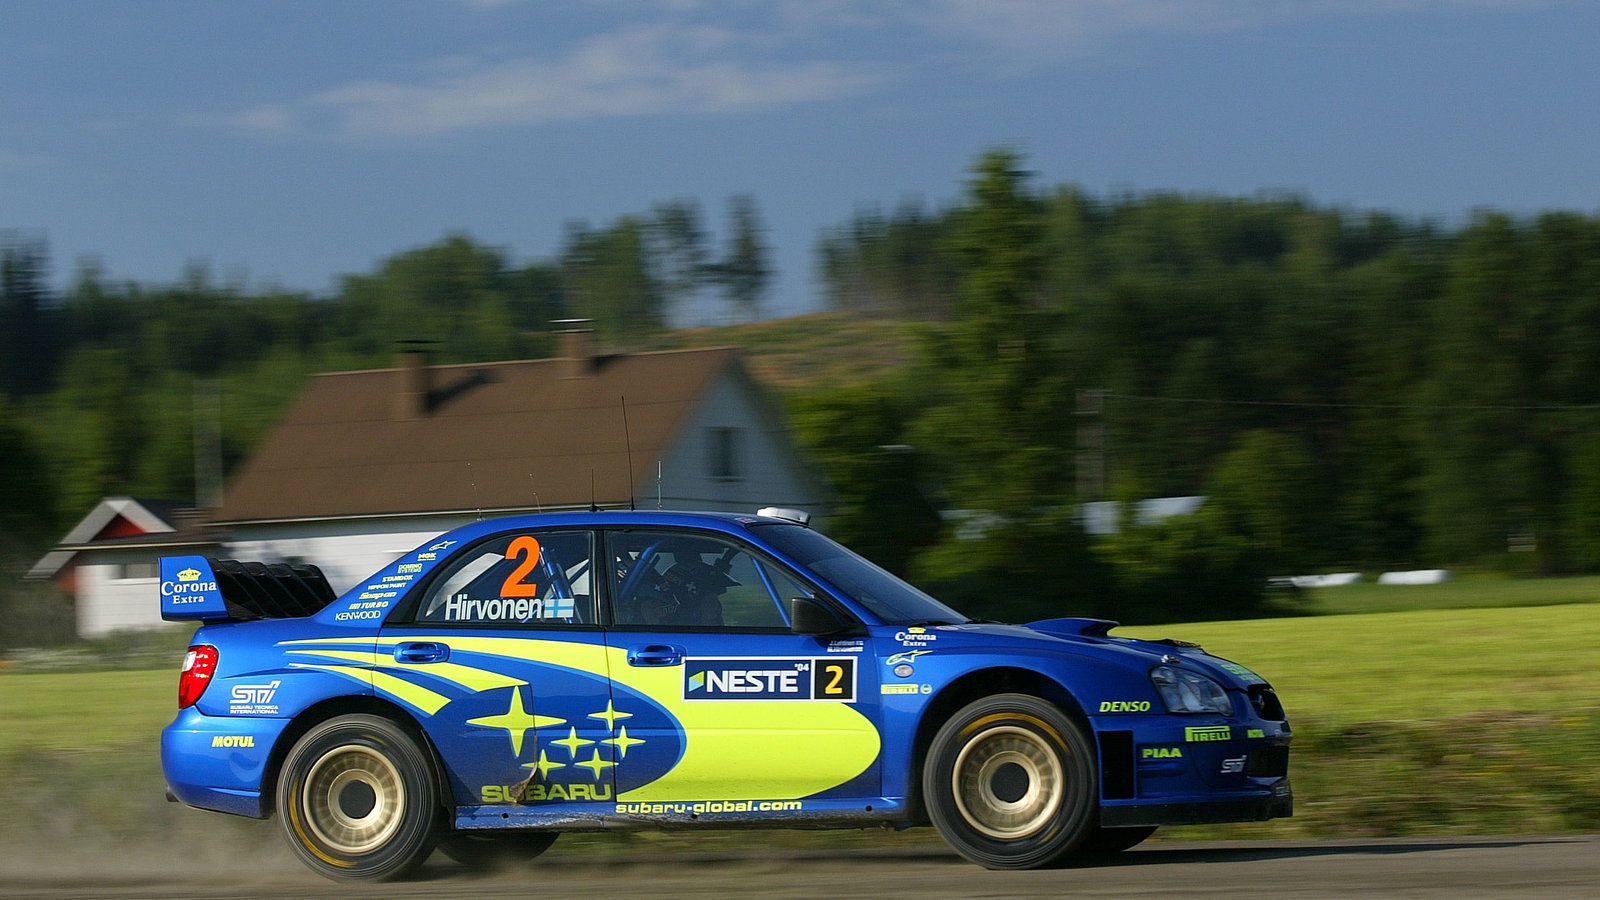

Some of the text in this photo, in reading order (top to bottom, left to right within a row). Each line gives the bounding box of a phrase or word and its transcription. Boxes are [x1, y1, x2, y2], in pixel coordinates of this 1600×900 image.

[500, 536, 540, 598] 2
[161, 581, 216, 596] Corona
[173, 595, 204, 604] Extra
[445, 594, 542, 620] Hirvonen
[335, 610, 381, 620] KENWOOD
[895, 632, 936, 642] Corona
[706, 663, 810, 692] NESTE '04
[824, 665, 844, 694] 2
[1100, 701, 1150, 712] DENSO
[1185, 726, 1232, 742] PIRELLI
[212, 736, 254, 747] MOTUL
[1142, 748, 1182, 758] PIAA
[481, 784, 612, 802] SUBARU
[616, 801, 802, 815] subaru-global.com
